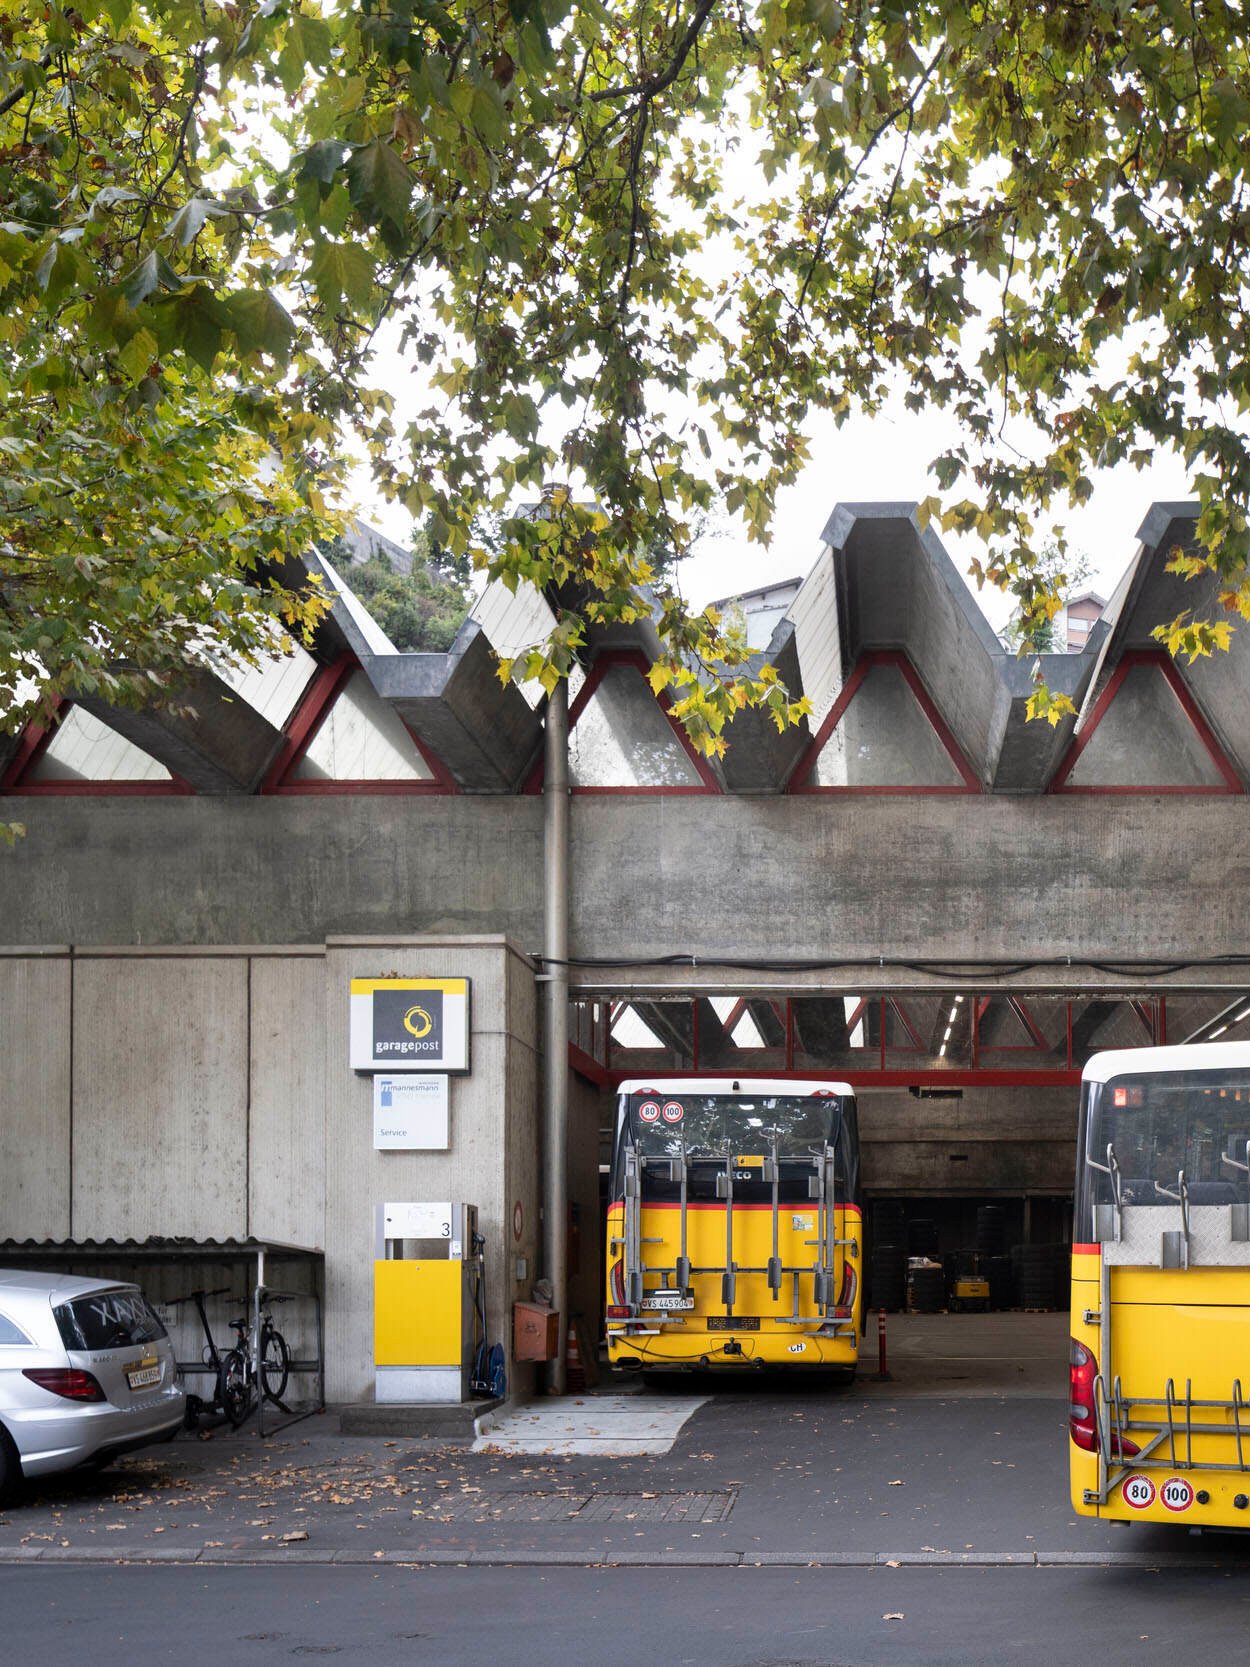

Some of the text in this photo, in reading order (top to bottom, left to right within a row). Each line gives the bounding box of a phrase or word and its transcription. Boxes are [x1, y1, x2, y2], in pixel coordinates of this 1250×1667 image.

[375, 1041, 439, 1053] garagepost
[645, 1107, 655, 1115] 80
[667, 1107, 680, 1115] 100
[442, 1223, 450, 1236] 3
[1131, 1485, 1148, 1499] 80
[1166, 1487, 1188, 1502] 100
